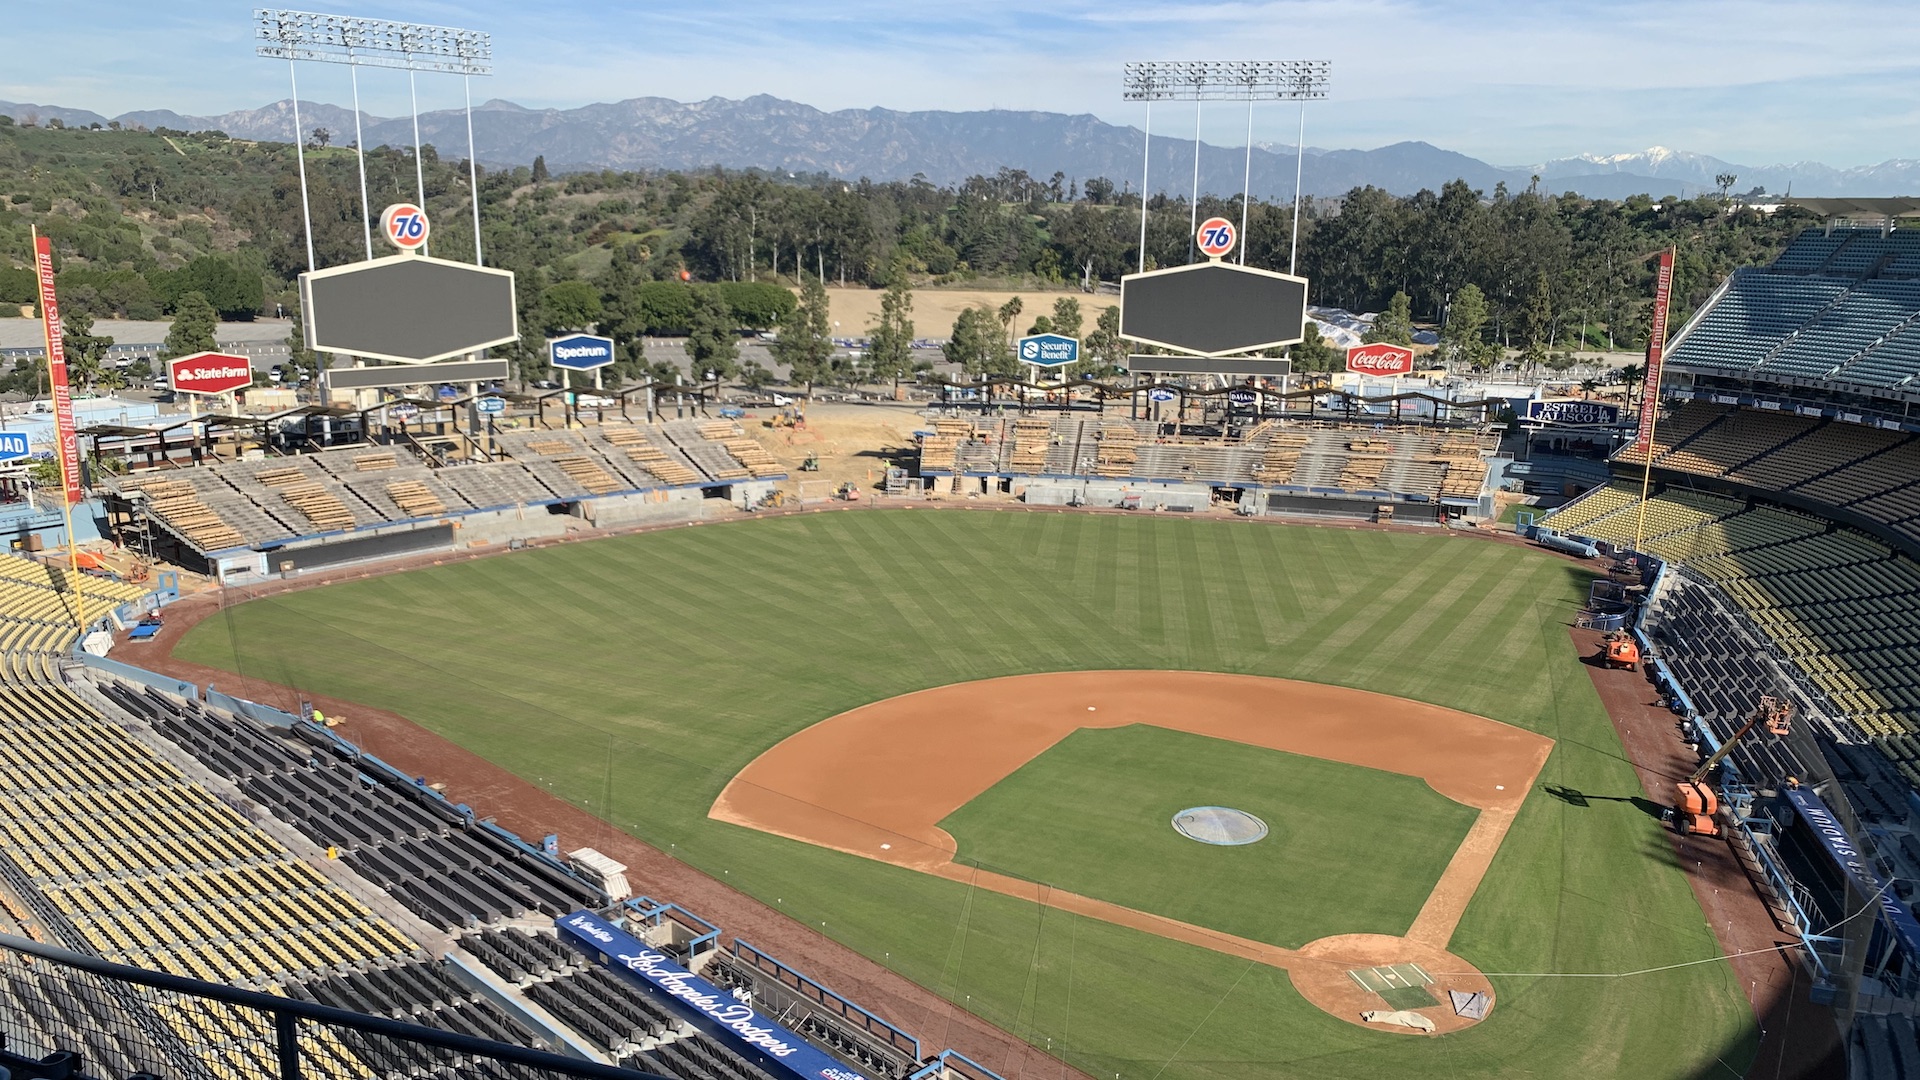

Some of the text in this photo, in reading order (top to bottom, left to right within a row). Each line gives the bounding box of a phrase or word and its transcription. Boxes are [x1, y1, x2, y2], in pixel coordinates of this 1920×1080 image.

[393, 213, 423, 238] 76
[1204, 226, 1230, 247] 76
[39, 253, 64, 364] Emirates FLY BETTER
[1651, 265, 1671, 349] Emirates FLY BETTER
[556, 346, 605, 360] Spectrum
[1041, 341, 1073, 353] Security
[1041, 350, 1069, 359] Benefit
[1351, 350, 1407, 370] Coca-Cola
[1640, 363, 1659, 444] Emirates FLY BETTER
[1535, 410, 1594, 423] JALISCO
[55, 385, 80, 492] Emirates FLY BETTER
[1806, 808, 1857, 856] STADIUM
[618, 950, 797, 1057] Los Angeles Dodgers
